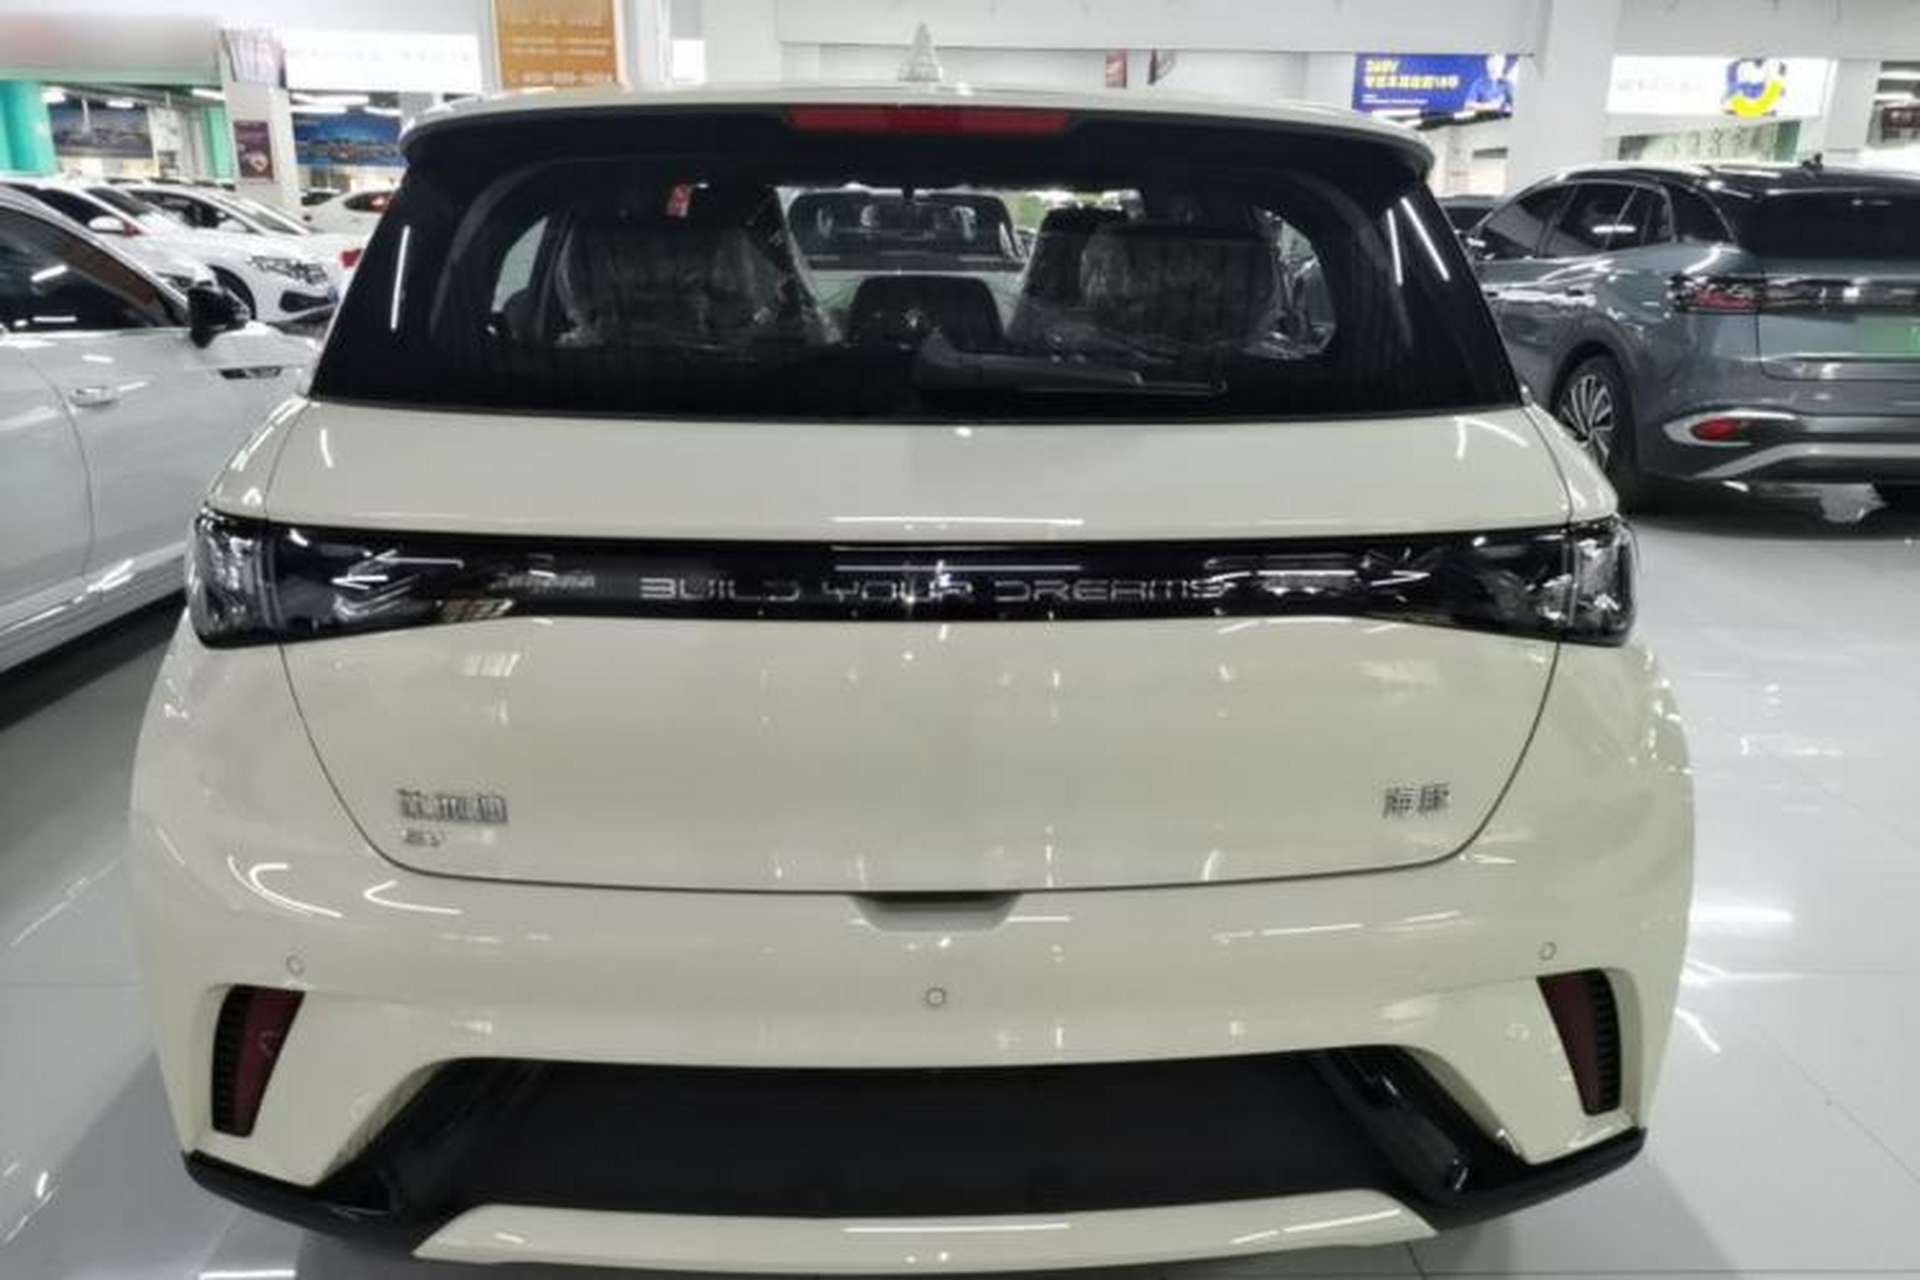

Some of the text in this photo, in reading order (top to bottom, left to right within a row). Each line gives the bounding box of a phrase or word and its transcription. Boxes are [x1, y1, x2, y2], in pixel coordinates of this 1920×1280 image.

[640, 576, 1224, 601] BUILD YOUR DREAMS
